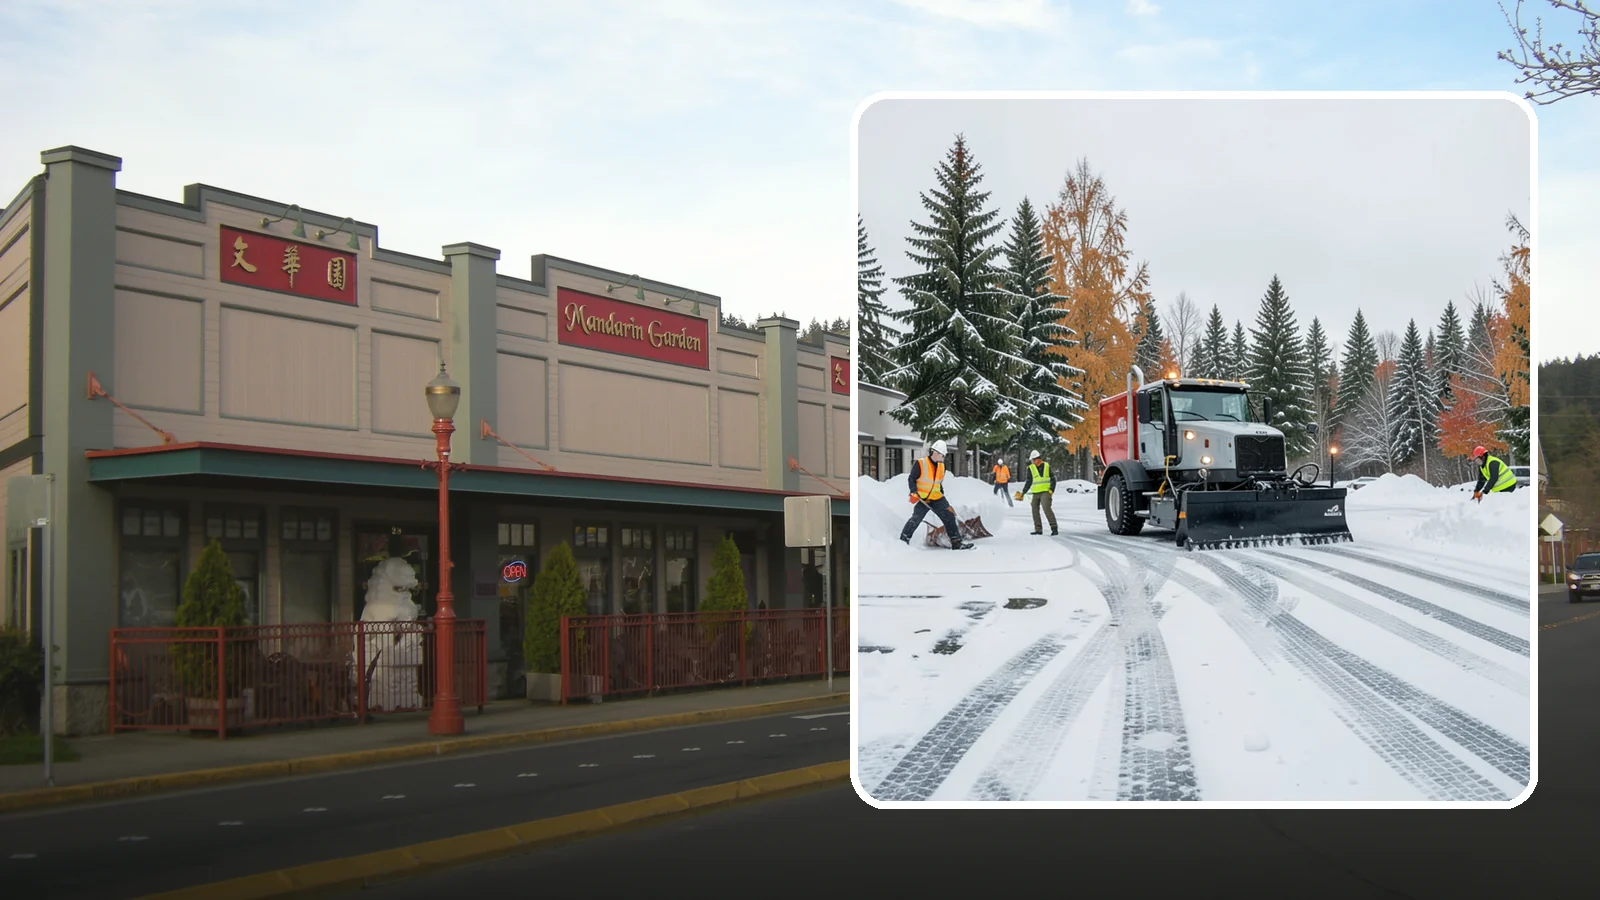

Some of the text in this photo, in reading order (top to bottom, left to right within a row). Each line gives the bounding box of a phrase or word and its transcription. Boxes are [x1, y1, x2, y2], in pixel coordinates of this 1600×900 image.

[564, 302, 701, 352] Mandarin Garden
[503, 565, 527, 578] OPEN
